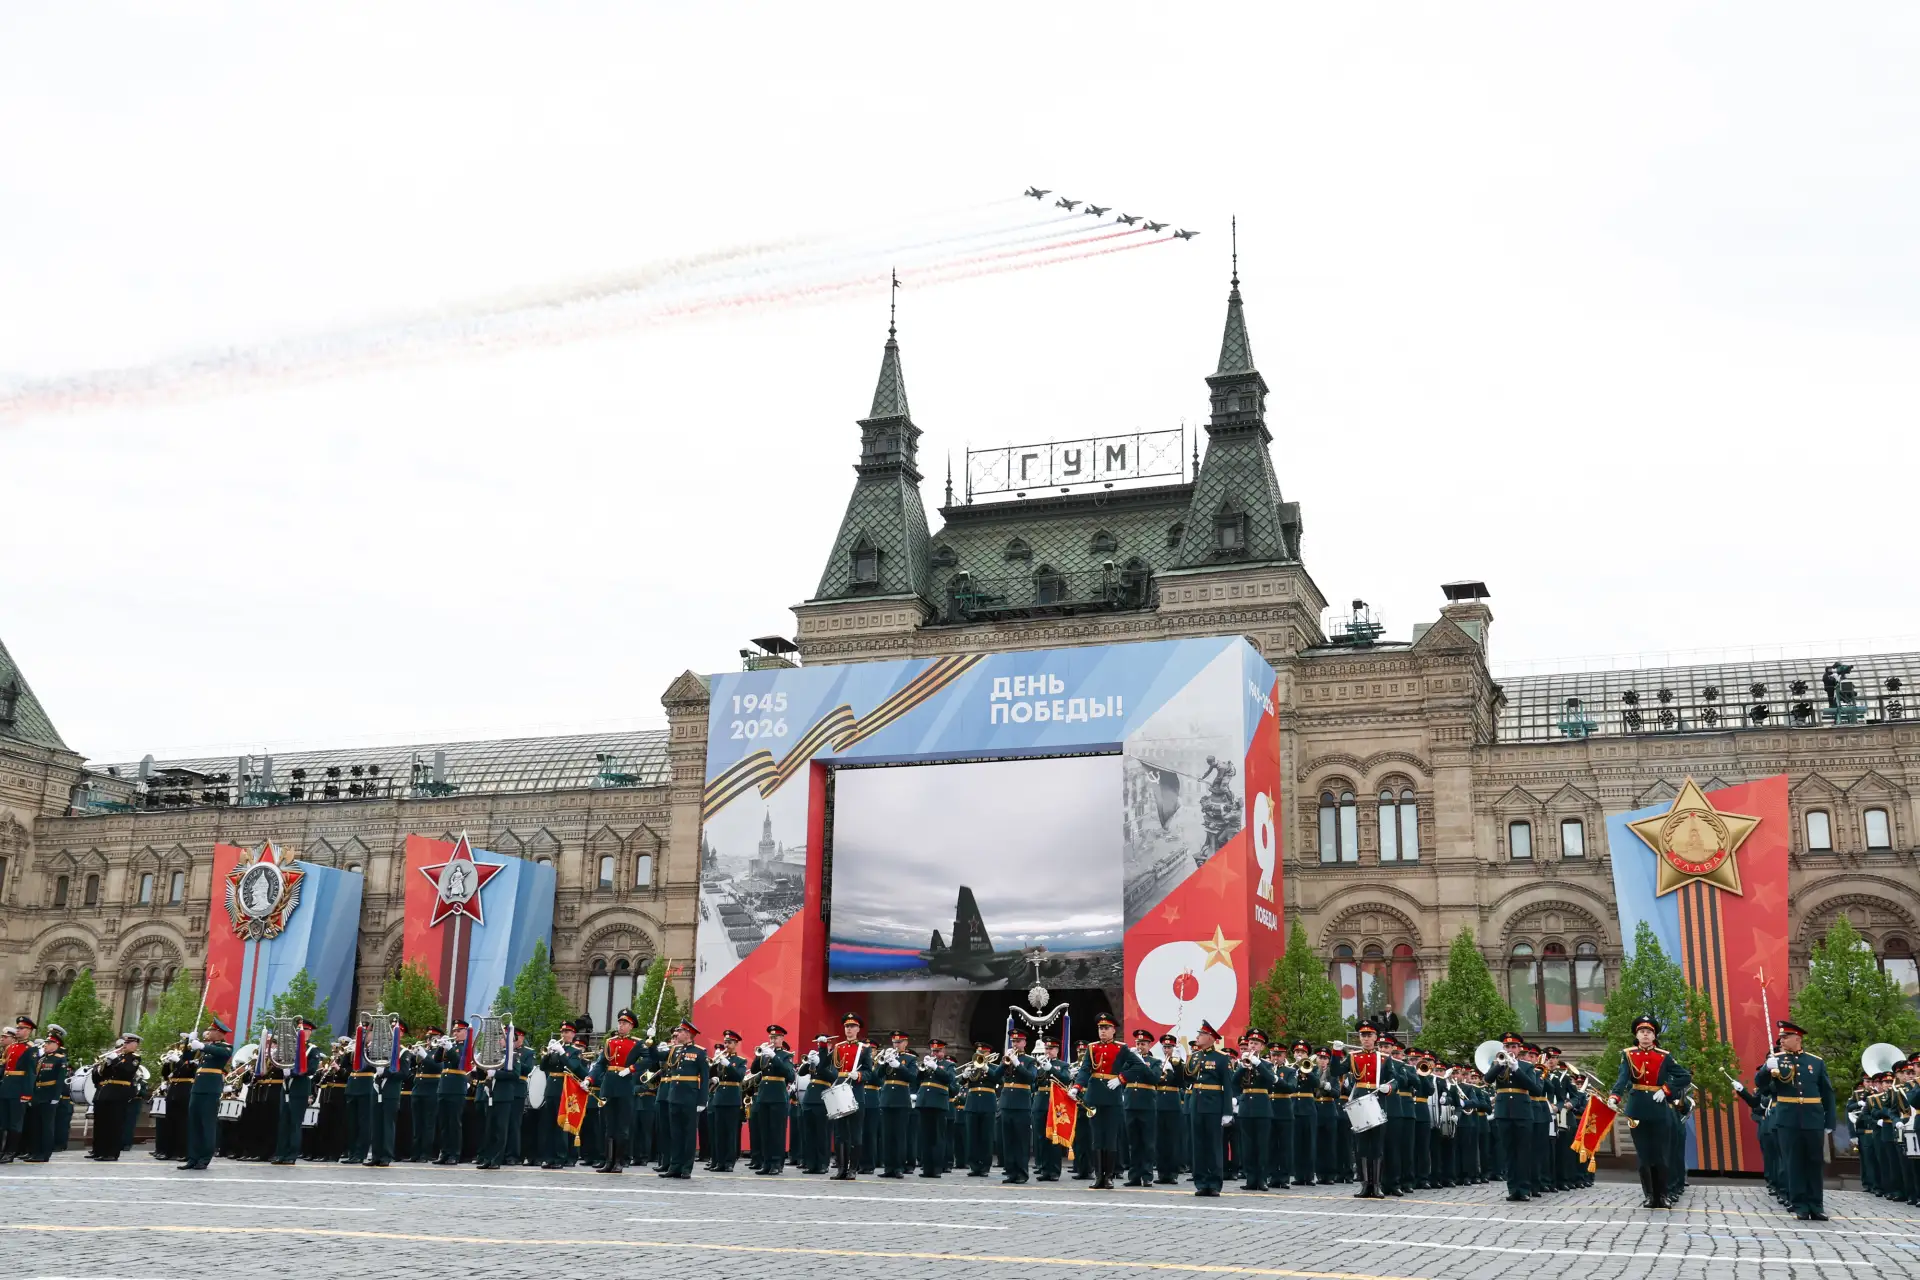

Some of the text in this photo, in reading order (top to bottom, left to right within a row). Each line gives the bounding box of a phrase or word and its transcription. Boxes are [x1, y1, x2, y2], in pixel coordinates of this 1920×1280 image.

[1021, 443, 1126, 480] ГУМ
[990, 673, 1065, 702] ДЕНЬ
[732, 691, 788, 714] 1945
[990, 695, 1124, 725] ПОБЕДЫ!
[730, 717, 788, 739] 2026
[1253, 791, 1275, 897] 9
[1674, 857, 1720, 871] СЛАВА
